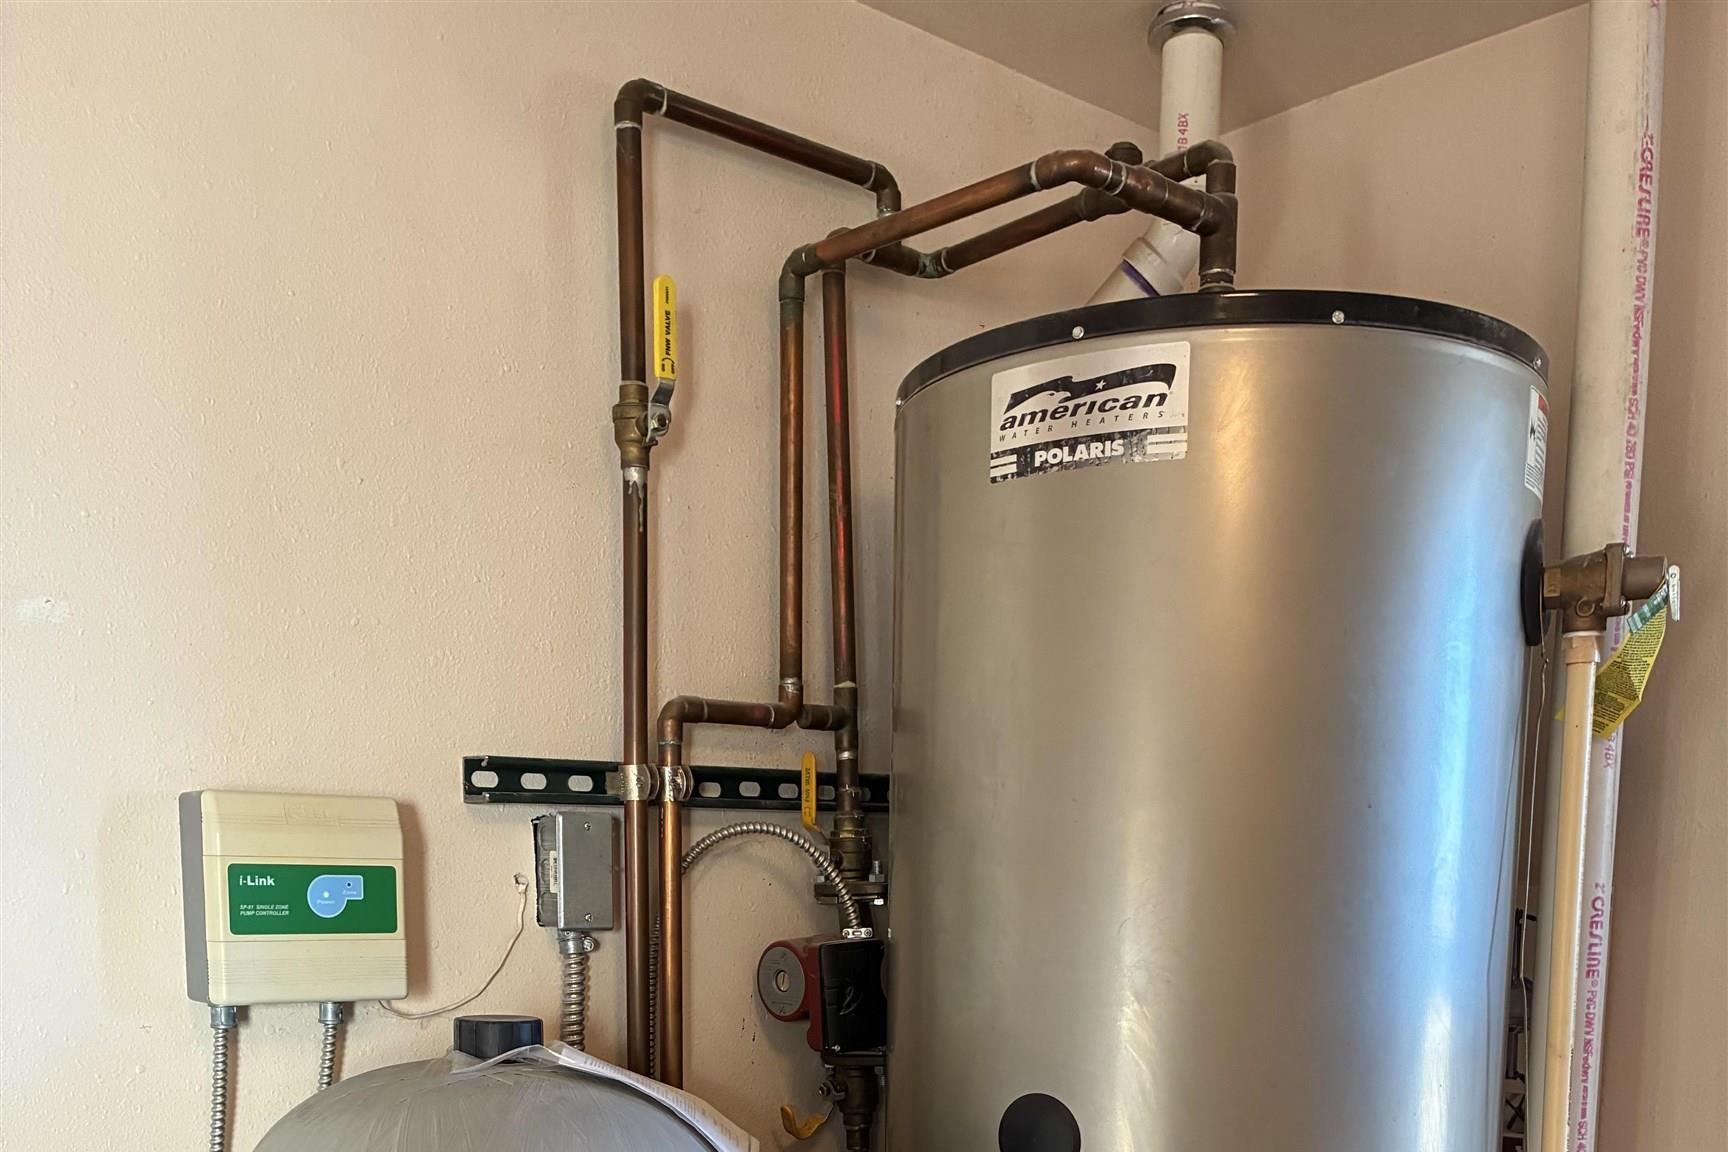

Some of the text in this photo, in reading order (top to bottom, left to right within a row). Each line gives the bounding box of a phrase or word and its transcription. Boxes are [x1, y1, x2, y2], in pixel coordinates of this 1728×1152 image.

[999, 391, 1168, 431] american
[999, 410, 1165, 442] WATER HEATERS
[1034, 439, 1124, 468] POLARIS
[239, 875, 275, 886] i-Link
[1577, 1120, 1588, 1141] SCH
